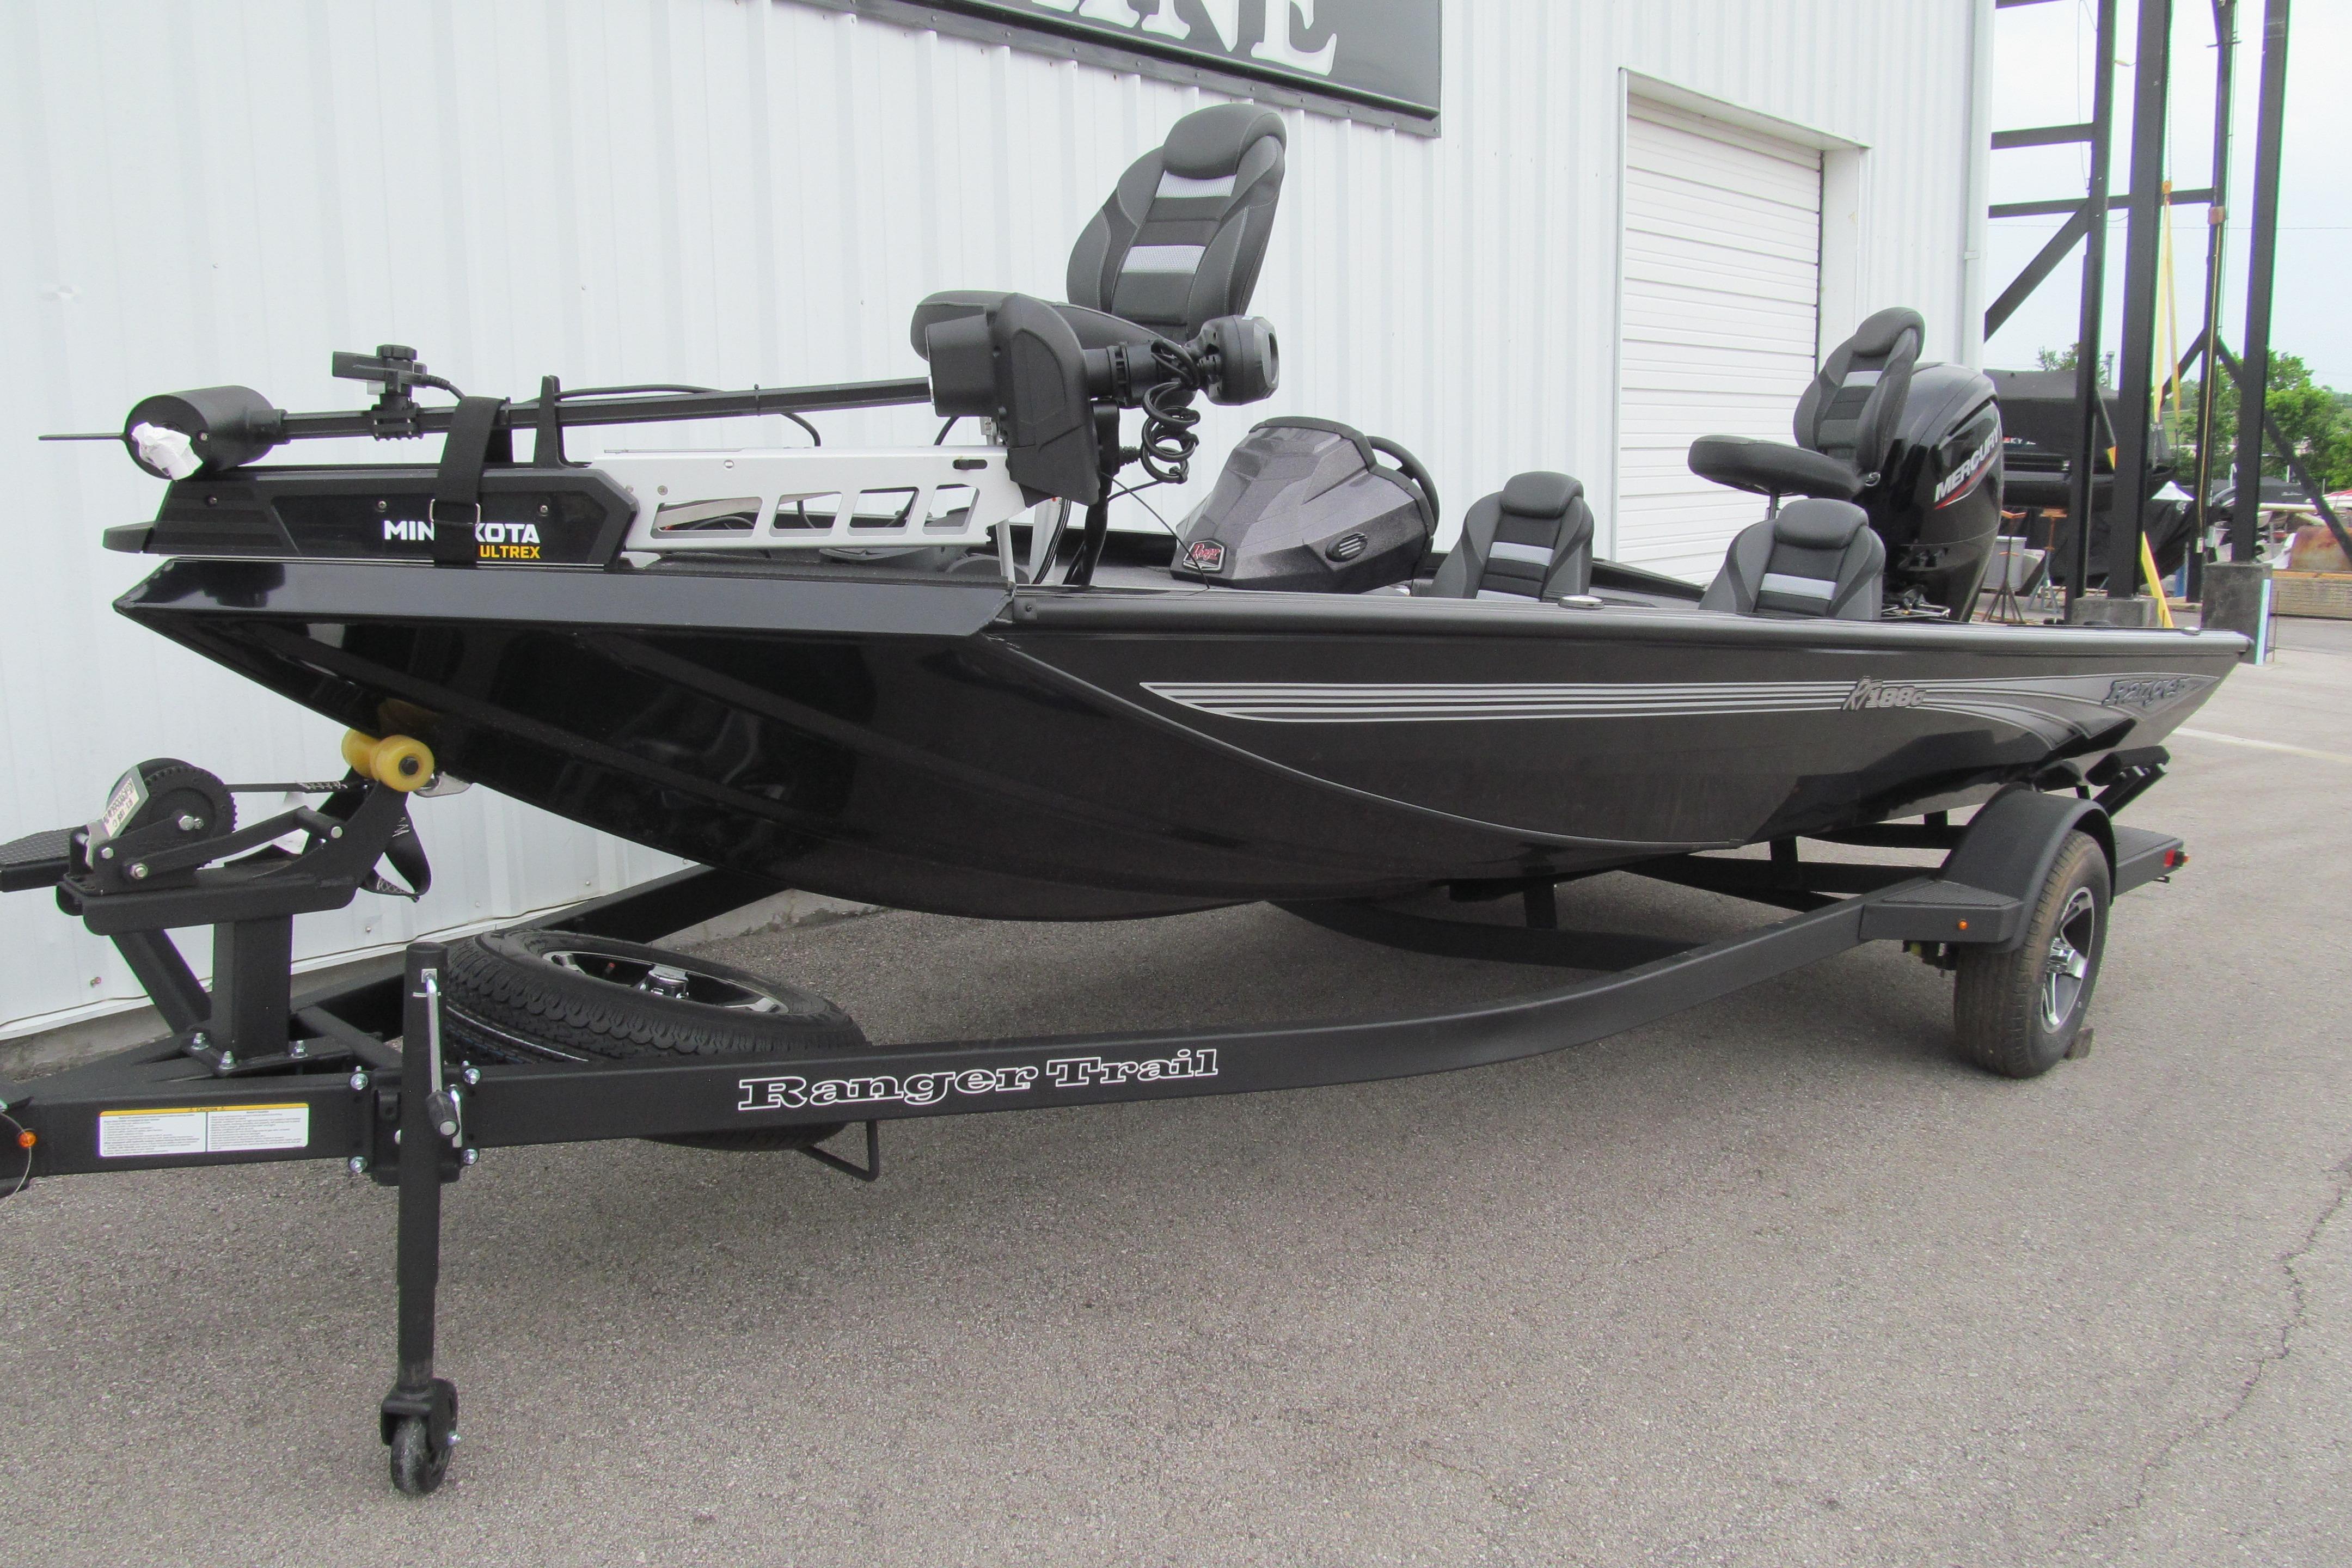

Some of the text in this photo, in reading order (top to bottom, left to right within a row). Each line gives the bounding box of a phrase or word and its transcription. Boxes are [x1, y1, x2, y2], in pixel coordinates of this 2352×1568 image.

[1934, 421, 1999, 503] MERCURY
[479, 545, 541, 559] ULTREX
[738, 1049, 1219, 1111] Ranger Trail
